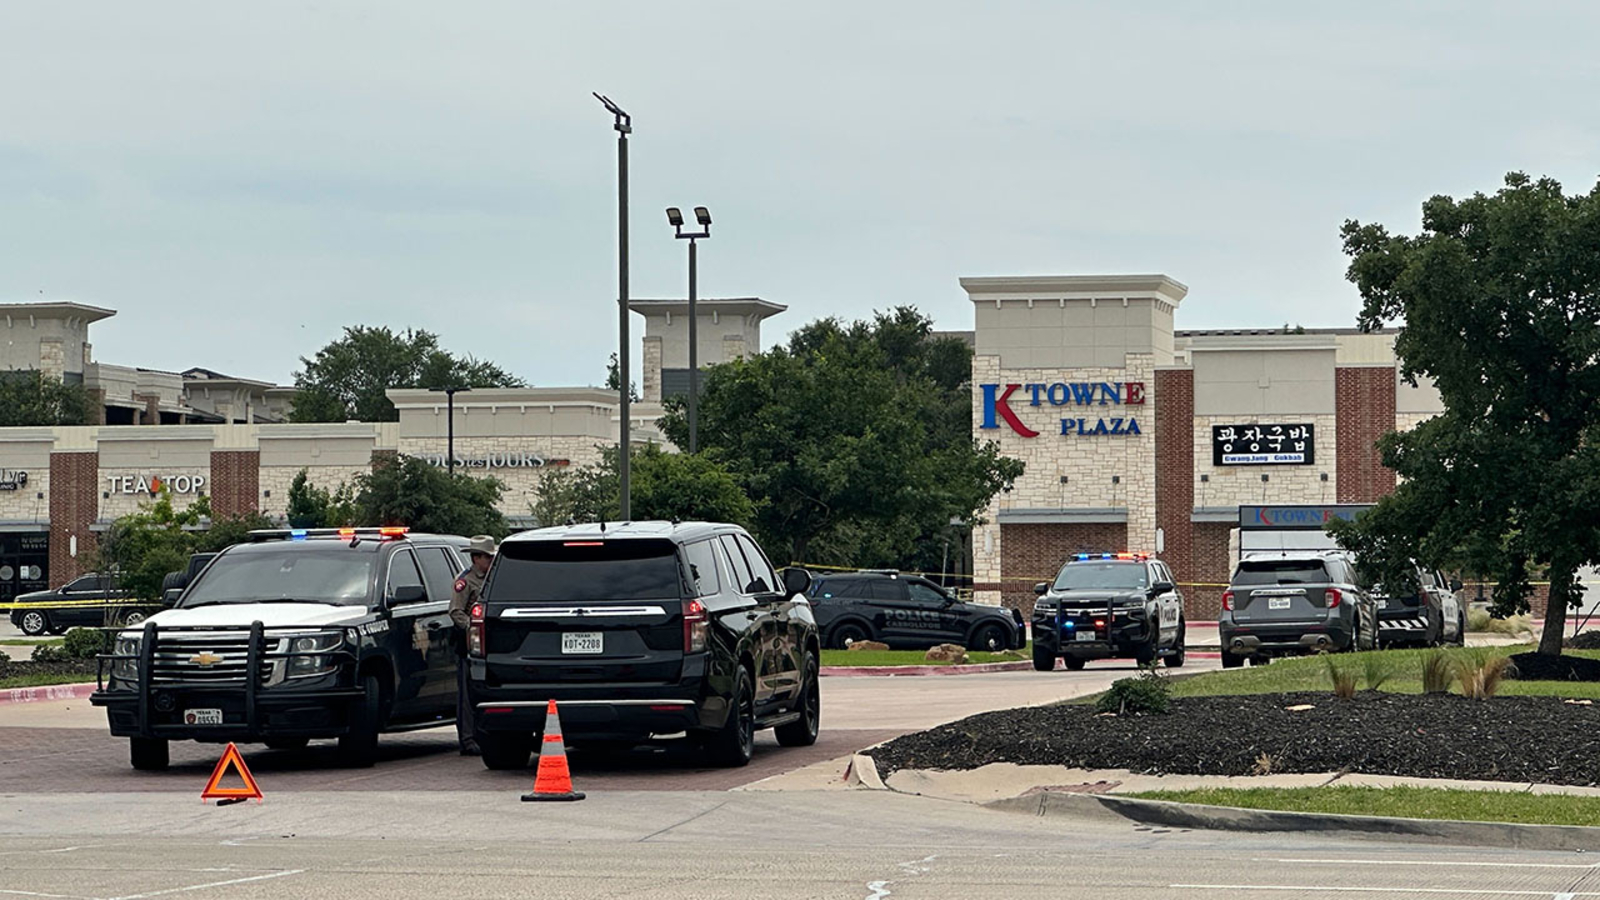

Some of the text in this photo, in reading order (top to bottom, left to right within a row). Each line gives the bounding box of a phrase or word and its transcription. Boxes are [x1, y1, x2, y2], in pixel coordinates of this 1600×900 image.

[1060, 417, 1142, 436] PLAZA
[1217, 425, 1310, 452] 광장국밥
[485, 452, 545, 470] JOURS
[107, 475, 205, 494] TEA TOP
[884, 609, 940, 622] POLICE
